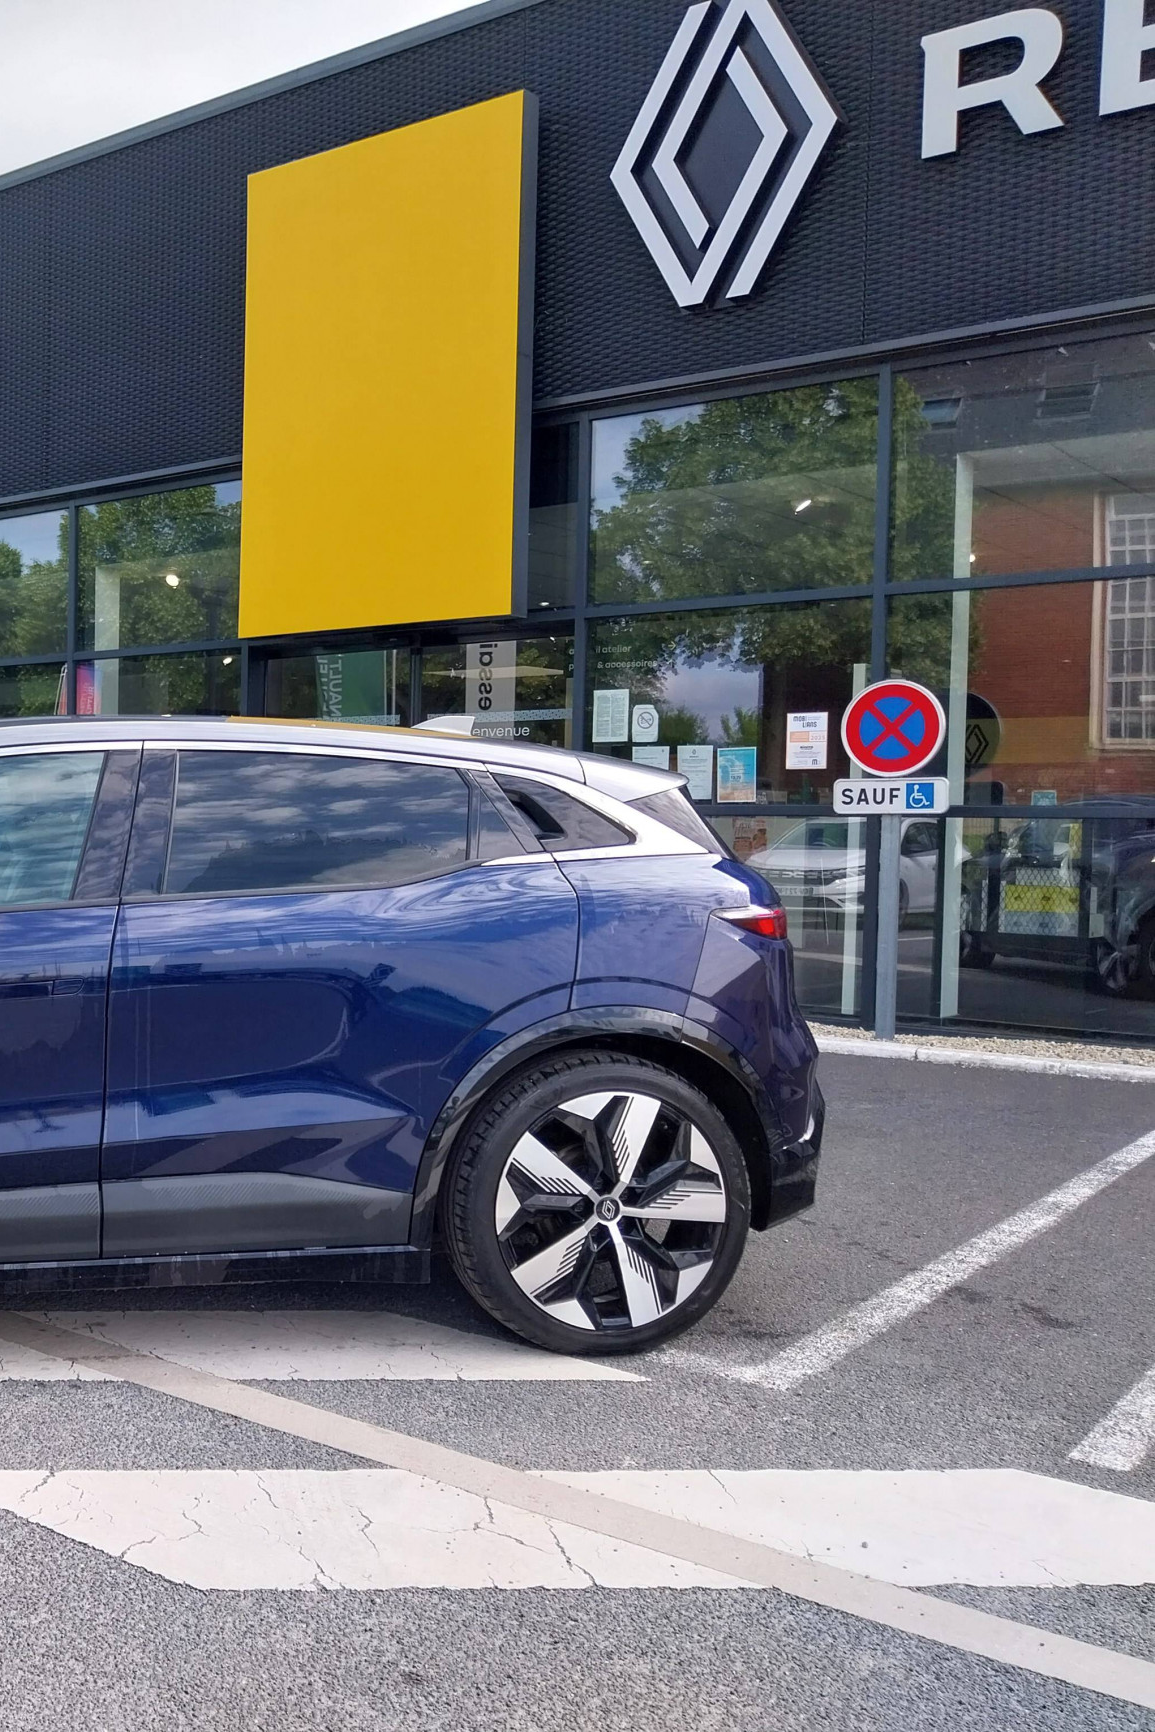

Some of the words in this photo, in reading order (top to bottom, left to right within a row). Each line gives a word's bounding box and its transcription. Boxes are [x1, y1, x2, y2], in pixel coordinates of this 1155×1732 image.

[603, 645, 631, 654] atelier
[472, 725, 530, 738] envenue
[841, 787, 901, 805] SAUF
